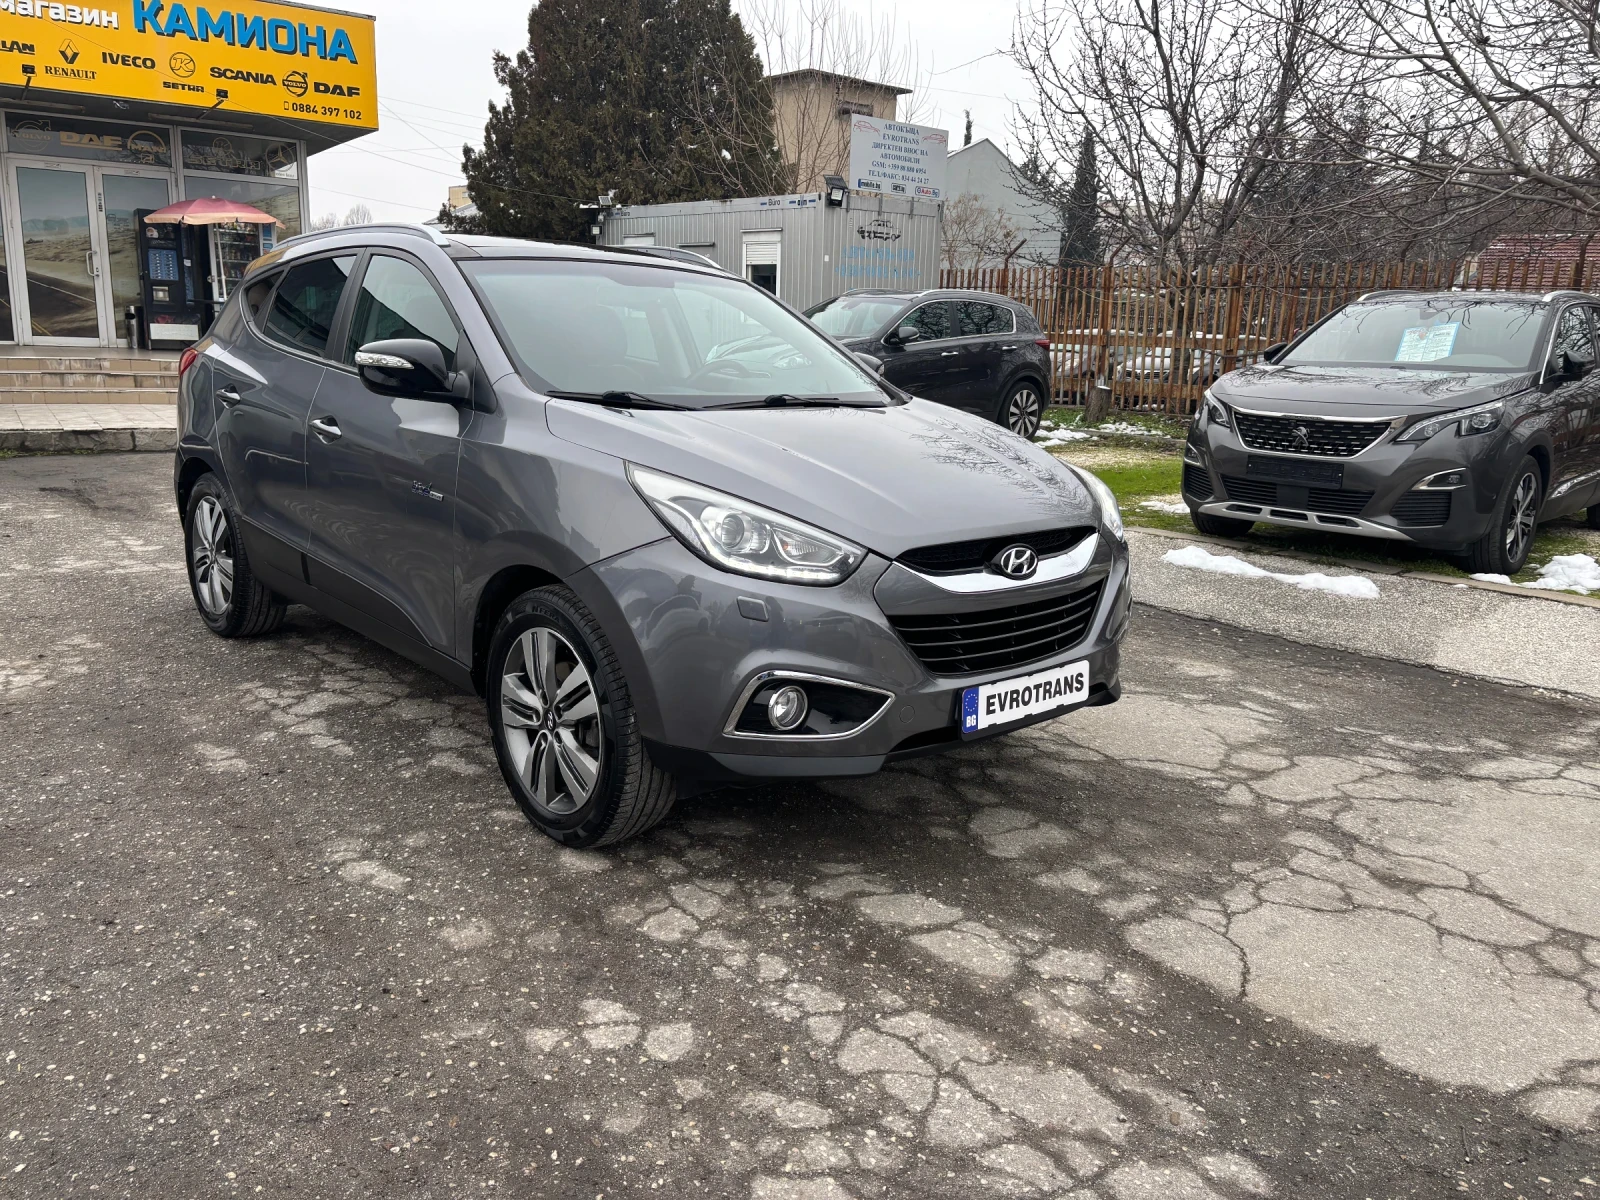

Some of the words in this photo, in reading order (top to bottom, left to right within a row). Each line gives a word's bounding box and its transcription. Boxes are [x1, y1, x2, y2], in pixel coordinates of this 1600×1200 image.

[132, 0, 358, 64] КАМИОНА
[101, 52, 156, 70] IVECO
[44, 65, 97, 80] RENAULT
[210, 66, 277, 86] SCANIA
[163, 81, 204, 93] SETRA
[283, 80, 307, 88] VOLVO
[314, 82, 360, 97] DAF
[292, 103, 318, 114] 0884
[321, 106, 340, 117] 397
[343, 109, 362, 120] 102
[60, 131, 122, 146] DAF
[883, 133, 920, 146] EVROTRANS
[872, 141, 903, 153] ДИРЕКТЕН
[903, 146, 920, 157] ВНОС
[871, 160, 887, 169] GSM:
[880, 152, 920, 165] АВТОМОБИЛИ
[768, 198, 780, 206] Büro
[986, 672, 1084, 716] EVROTRANS
[966, 715, 977, 728] BG
